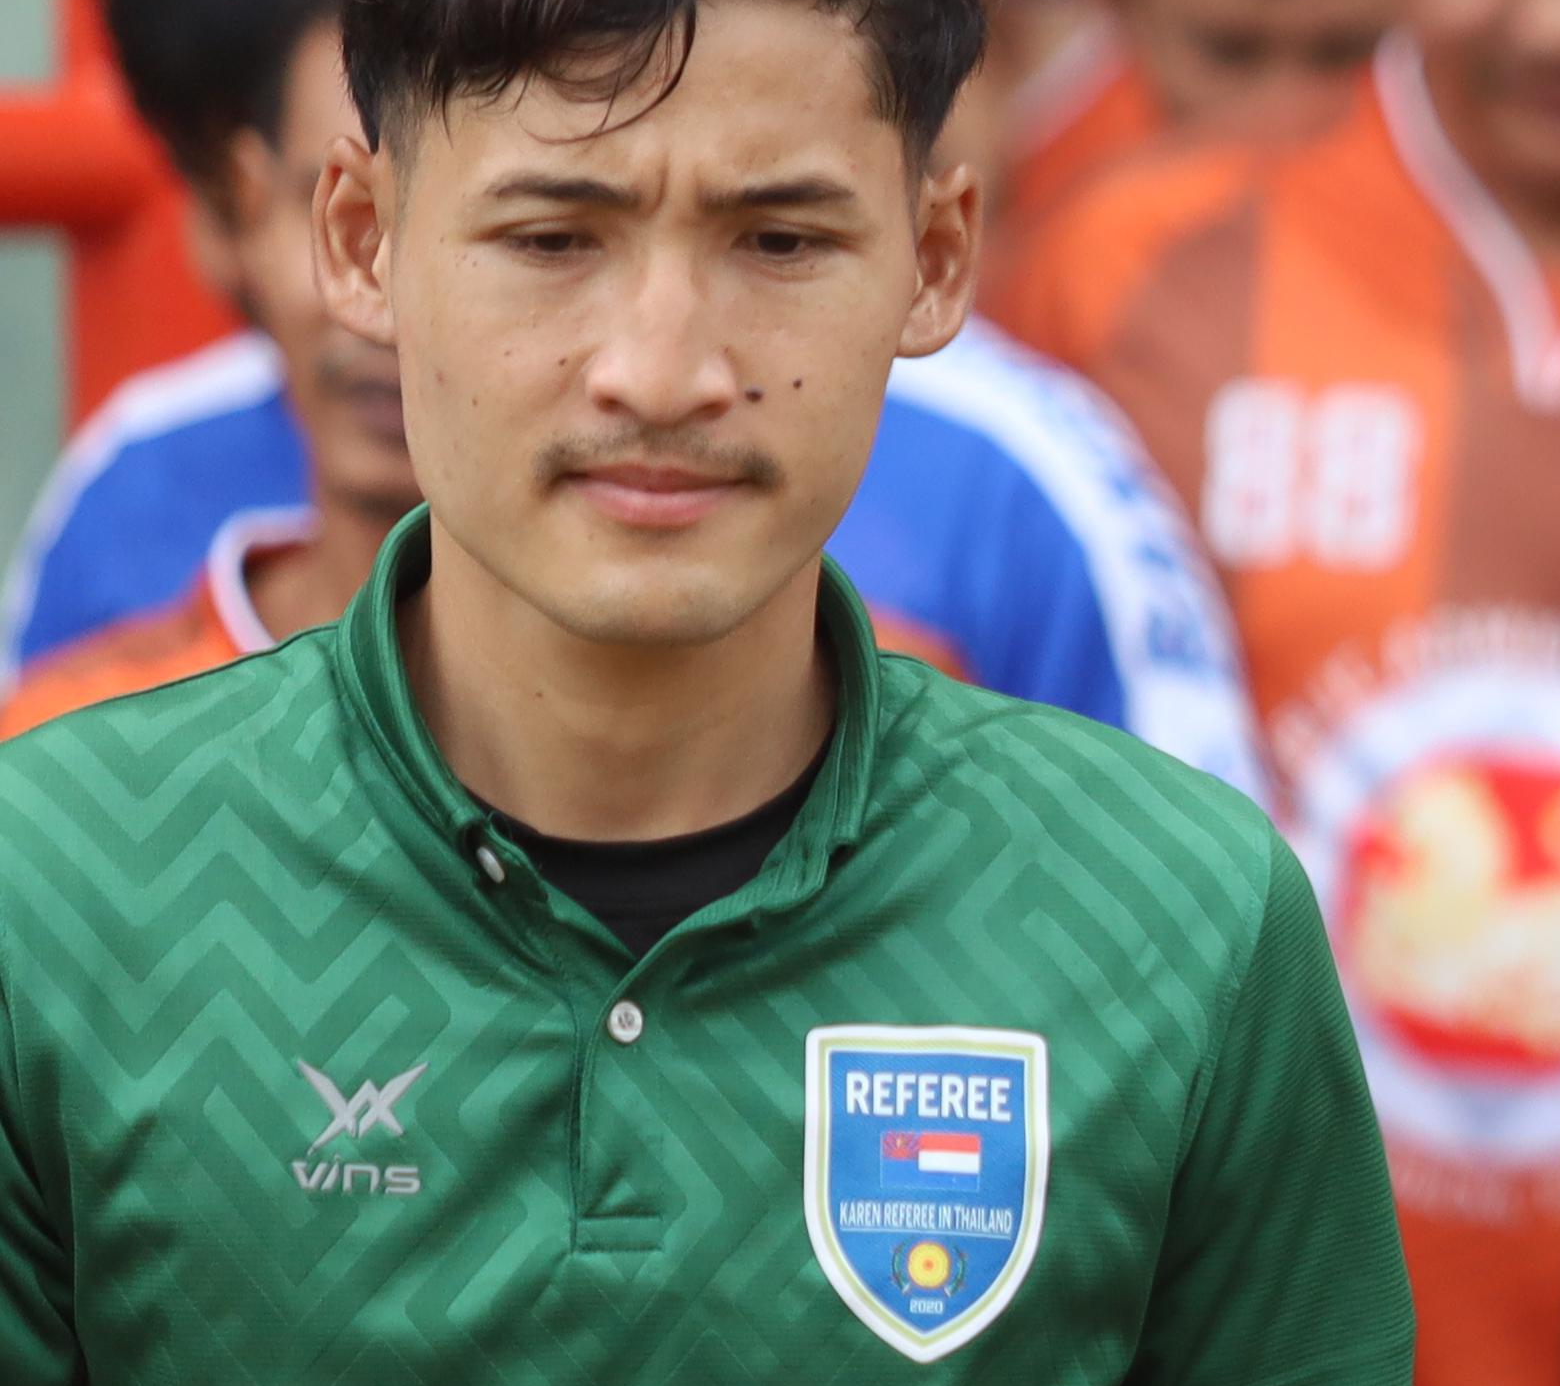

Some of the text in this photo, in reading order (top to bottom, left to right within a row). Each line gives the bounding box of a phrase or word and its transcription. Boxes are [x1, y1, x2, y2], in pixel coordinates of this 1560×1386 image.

[1201, 378, 1420, 571] 88
[845, 1071, 1012, 1122] REFEREE
[840, 1201, 1013, 1234] KAREN REFEREE IN THAILAND
[909, 1299, 945, 1315] 2020
